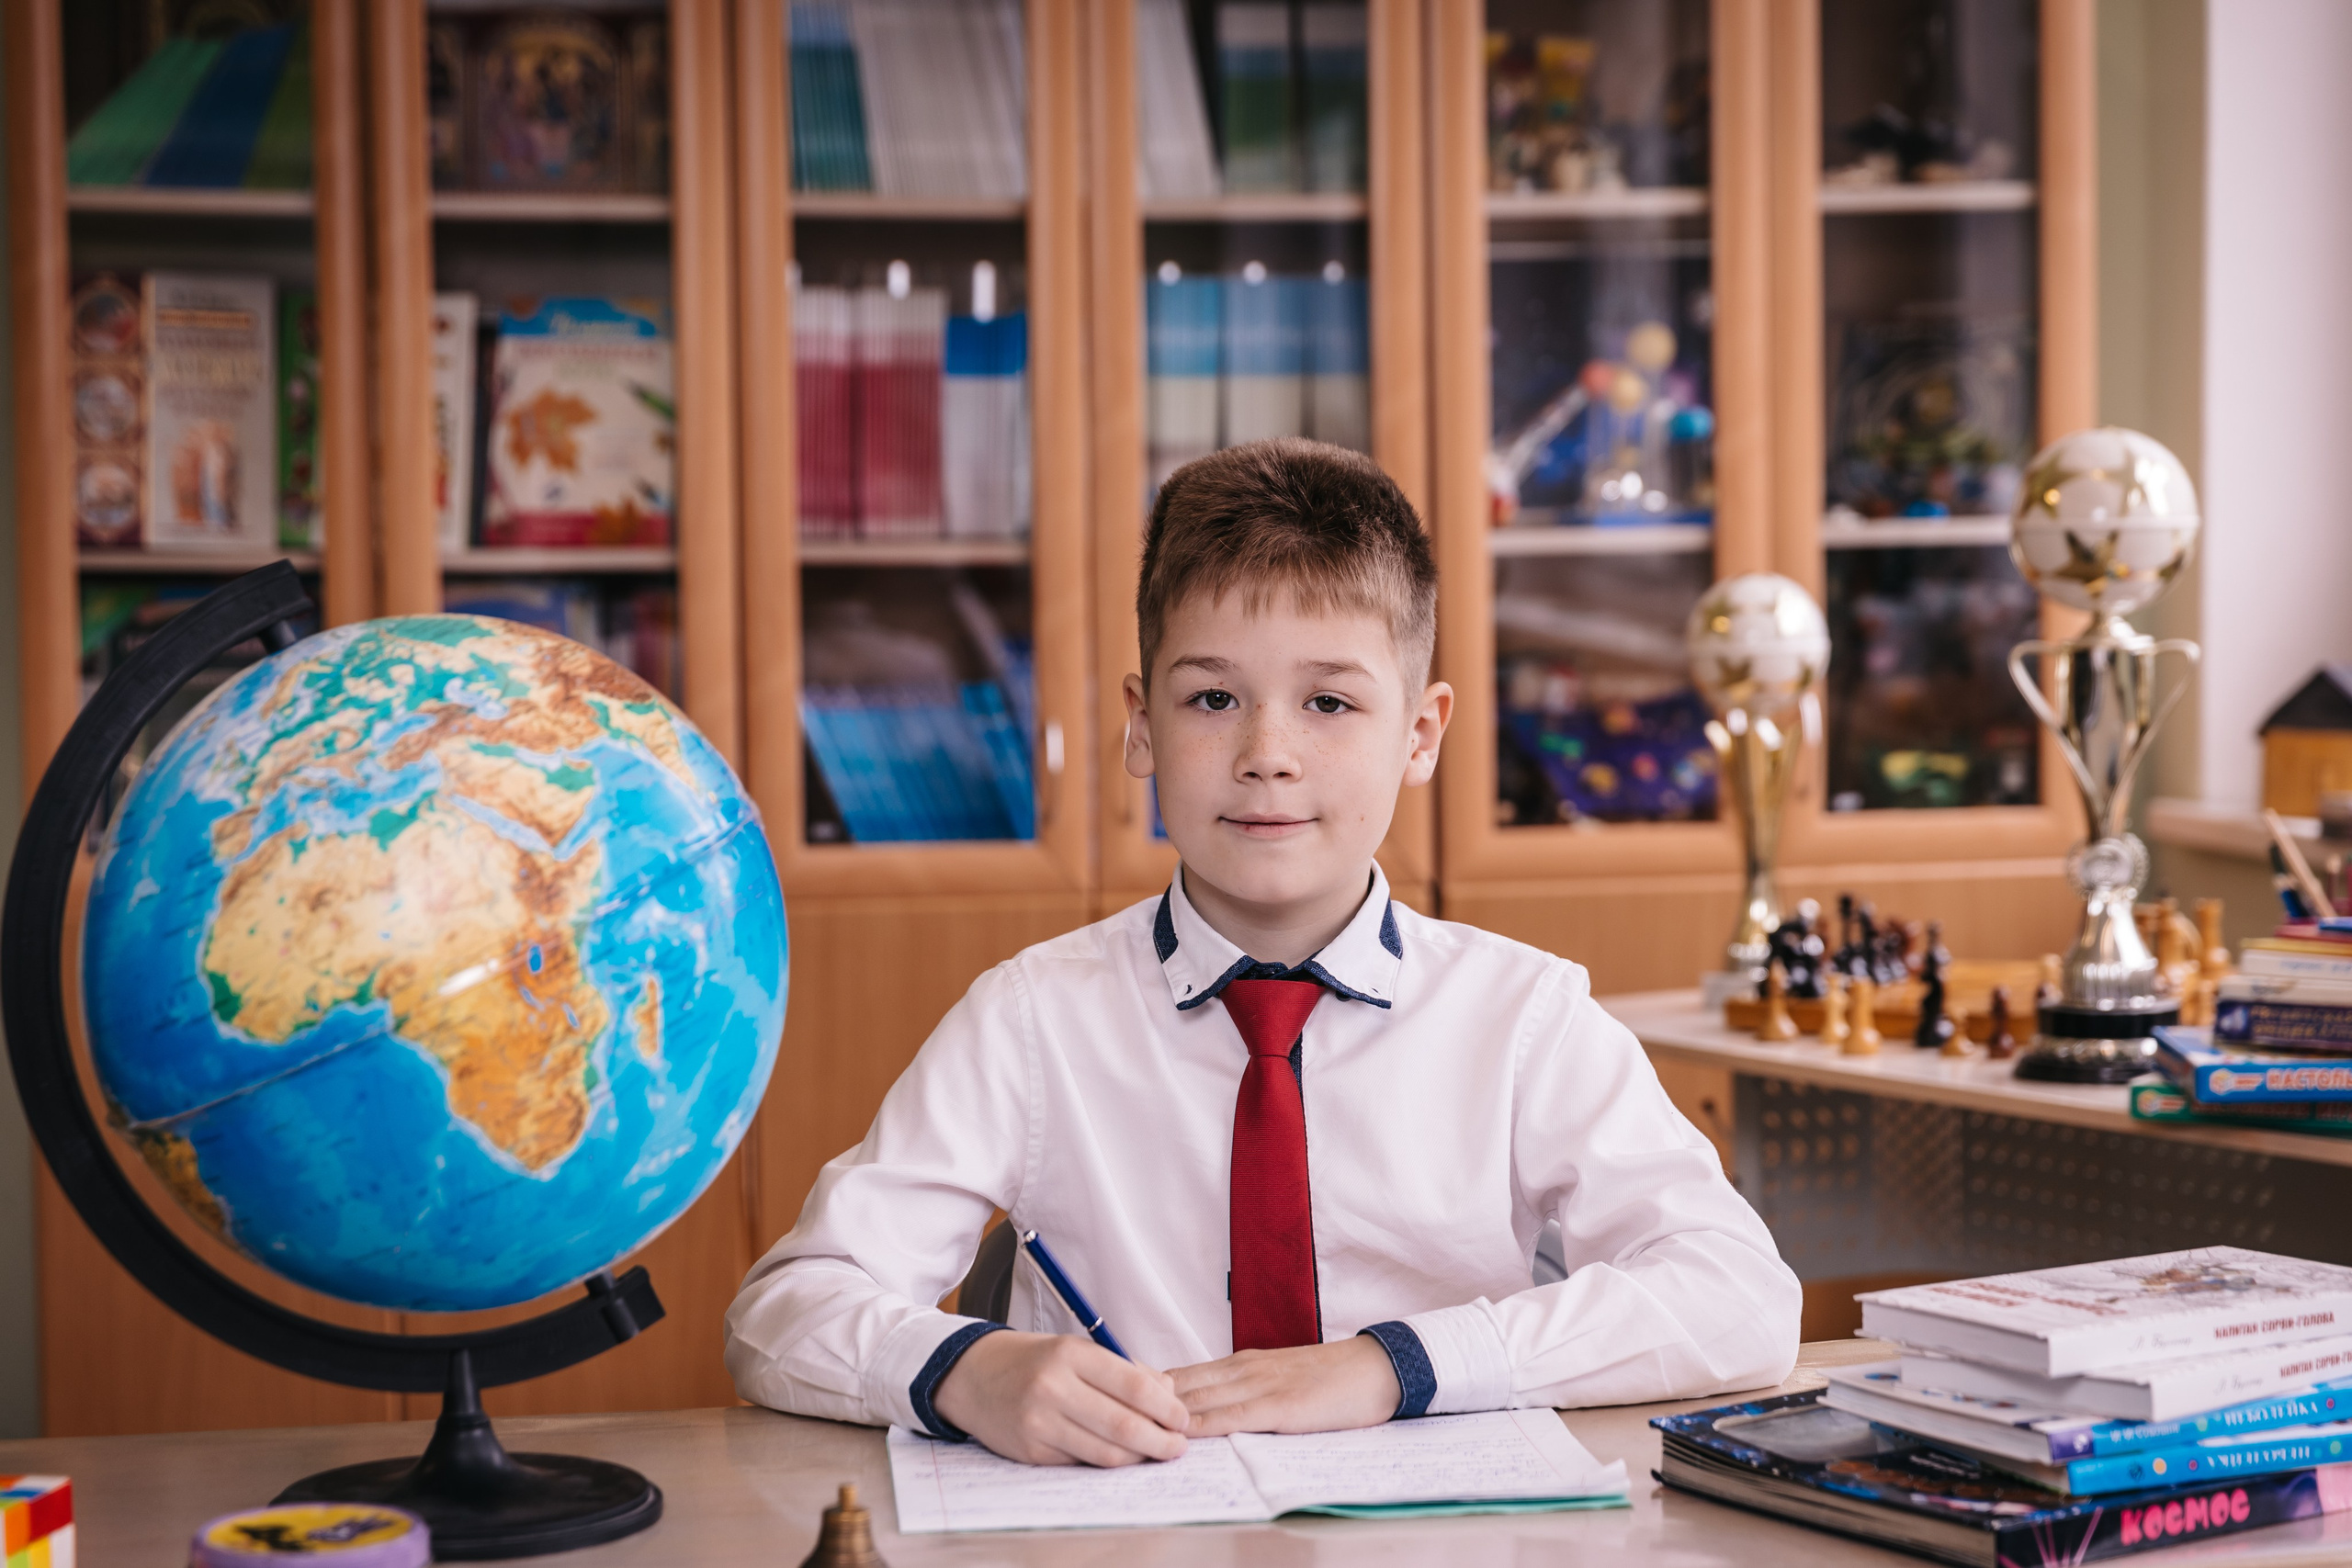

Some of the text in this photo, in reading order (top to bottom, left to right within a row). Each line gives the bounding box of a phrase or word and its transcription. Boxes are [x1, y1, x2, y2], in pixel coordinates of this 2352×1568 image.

[2214, 1311, 2335, 1339] КАПИТАН СОРВИ-ГОЛОВА
[2280, 1359, 2313, 1378] КАПИТАН
[2120, 1488, 2251, 1546] КОСМОС
